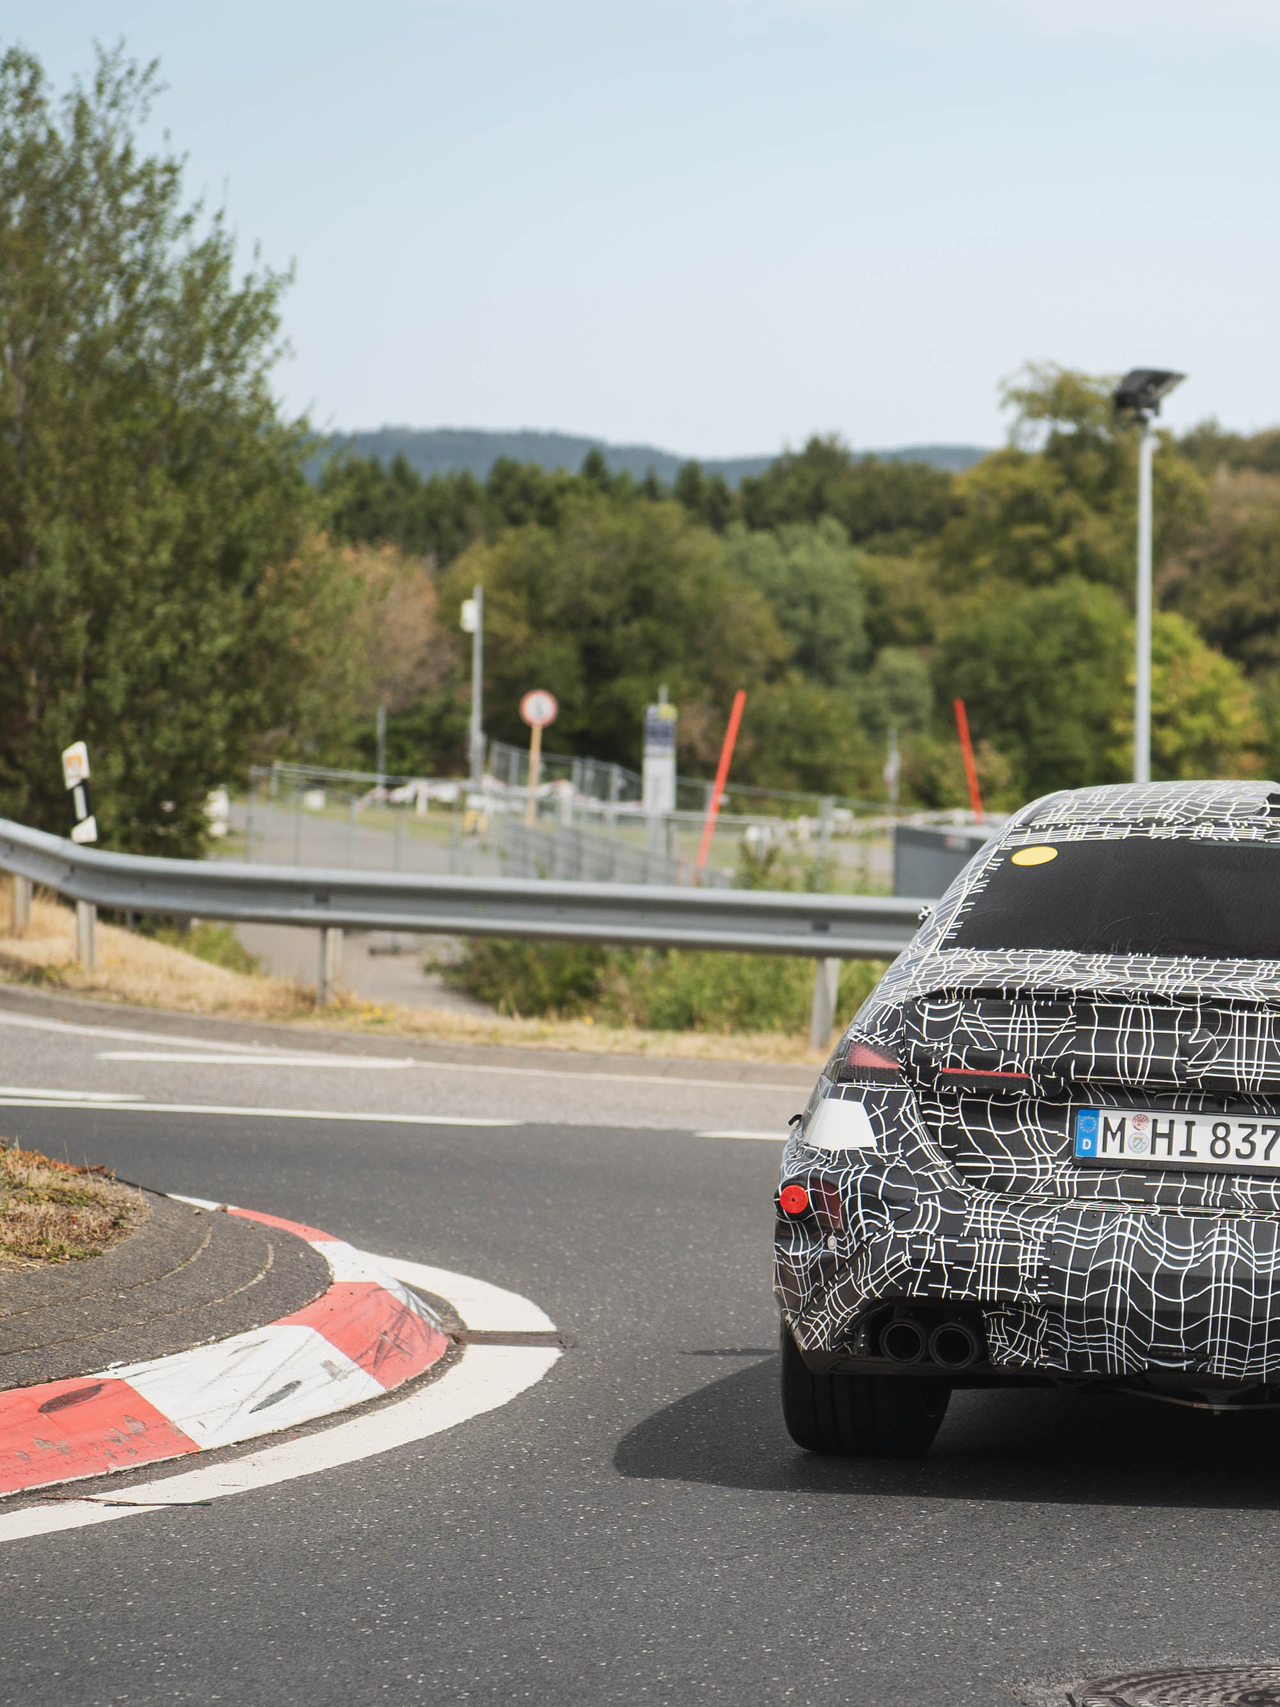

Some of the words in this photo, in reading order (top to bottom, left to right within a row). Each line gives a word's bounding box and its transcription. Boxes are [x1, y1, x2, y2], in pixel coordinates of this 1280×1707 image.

[1082, 1138, 1092, 1150] D
[1101, 1116, 1127, 1154] M
[1150, 1118, 1198, 1157] HI
